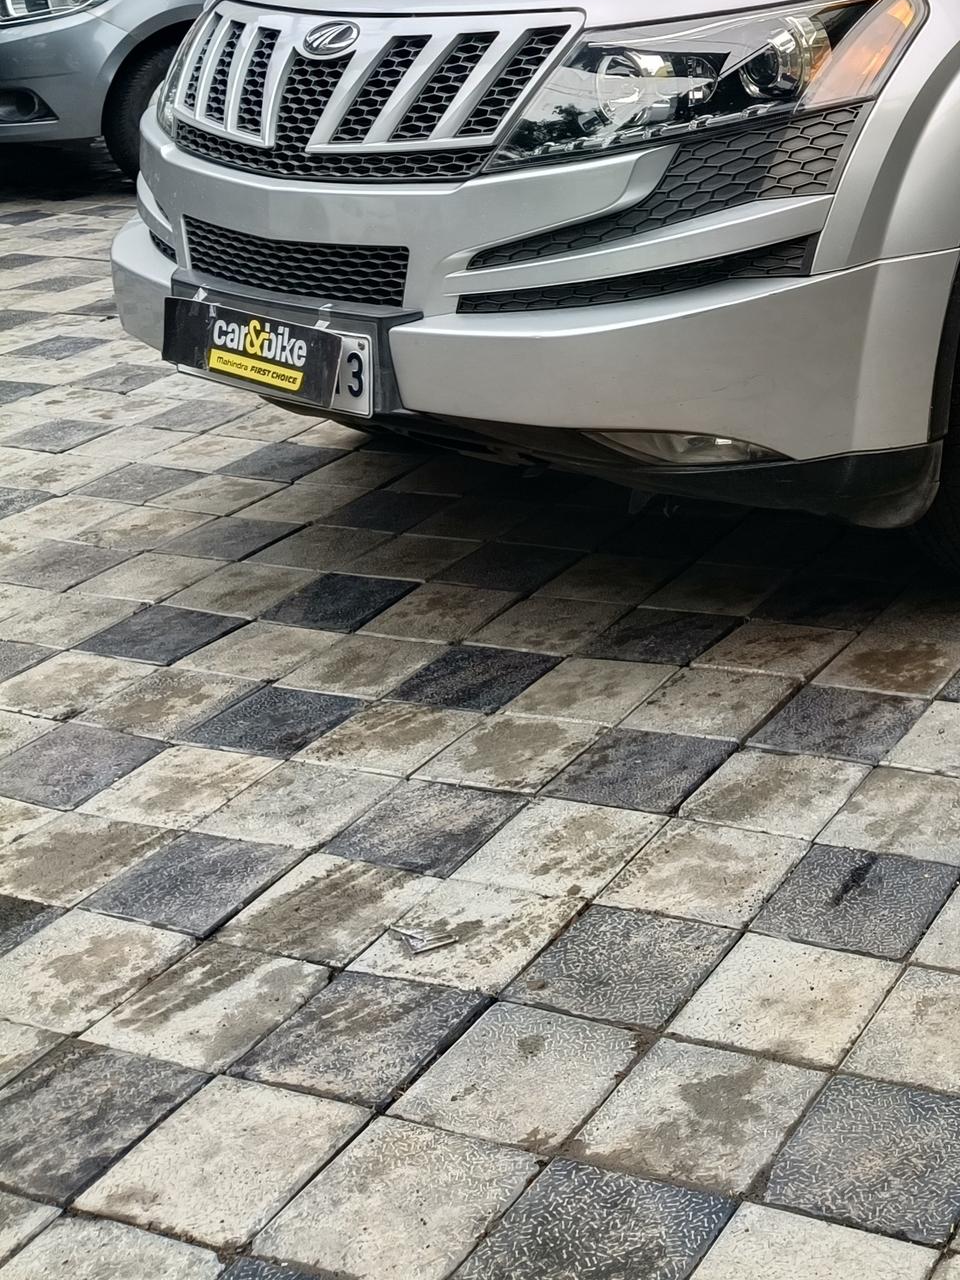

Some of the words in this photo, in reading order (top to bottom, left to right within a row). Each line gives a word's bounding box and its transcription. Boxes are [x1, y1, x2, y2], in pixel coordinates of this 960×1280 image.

[213, 319, 307, 367] car&bike
[216, 357, 249, 371] Mahindra
[249, 365, 272, 377] FIRST
[270, 371, 298, 385] CHOICE
